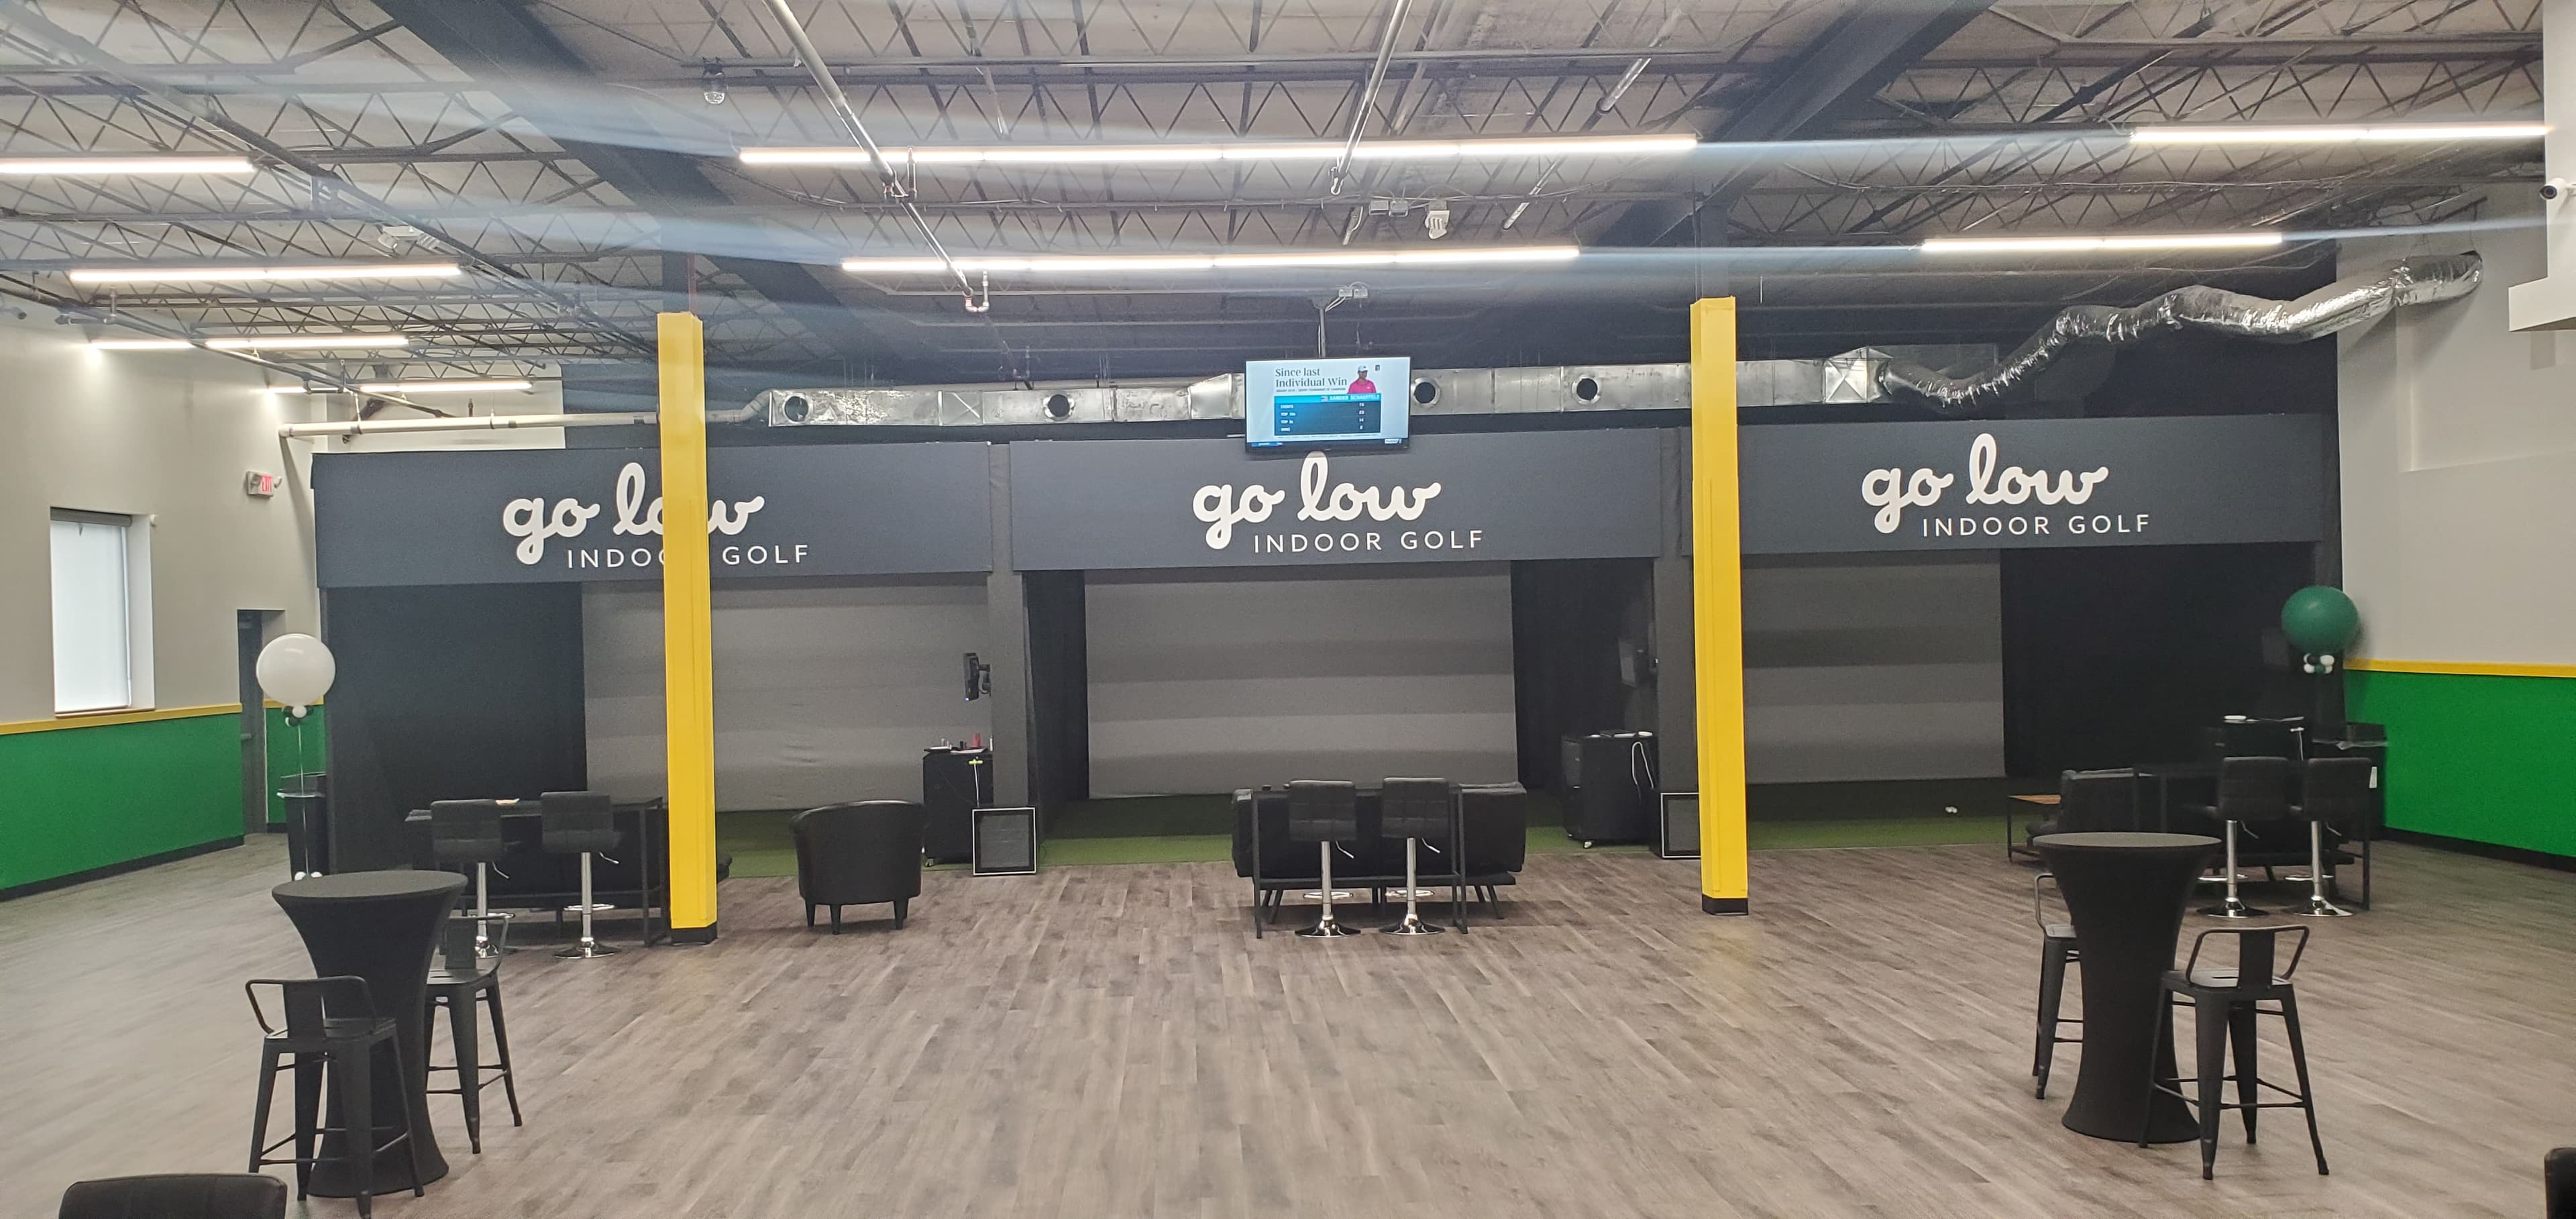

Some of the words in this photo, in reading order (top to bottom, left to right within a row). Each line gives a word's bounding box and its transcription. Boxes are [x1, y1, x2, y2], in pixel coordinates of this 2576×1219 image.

[1275, 368, 1301, 377] Since
[1303, 368, 1320, 376] last
[1276, 378, 1326, 387] Individual
[1328, 377, 1347, 386] Win
[1862, 468, 1953, 534] go
[1966, 433, 2108, 505] low
[1193, 484, 1285, 549] go
[1297, 451, 1441, 521] low
[503, 498, 600, 565] go
[1923, 517, 2049, 537] INDOOR
[2069, 515, 2148, 533] GOLF
[1255, 533, 1381, 553] INDOOR
[1401, 531, 1482, 549] GOLF
[722, 545, 807, 564] GOLF
